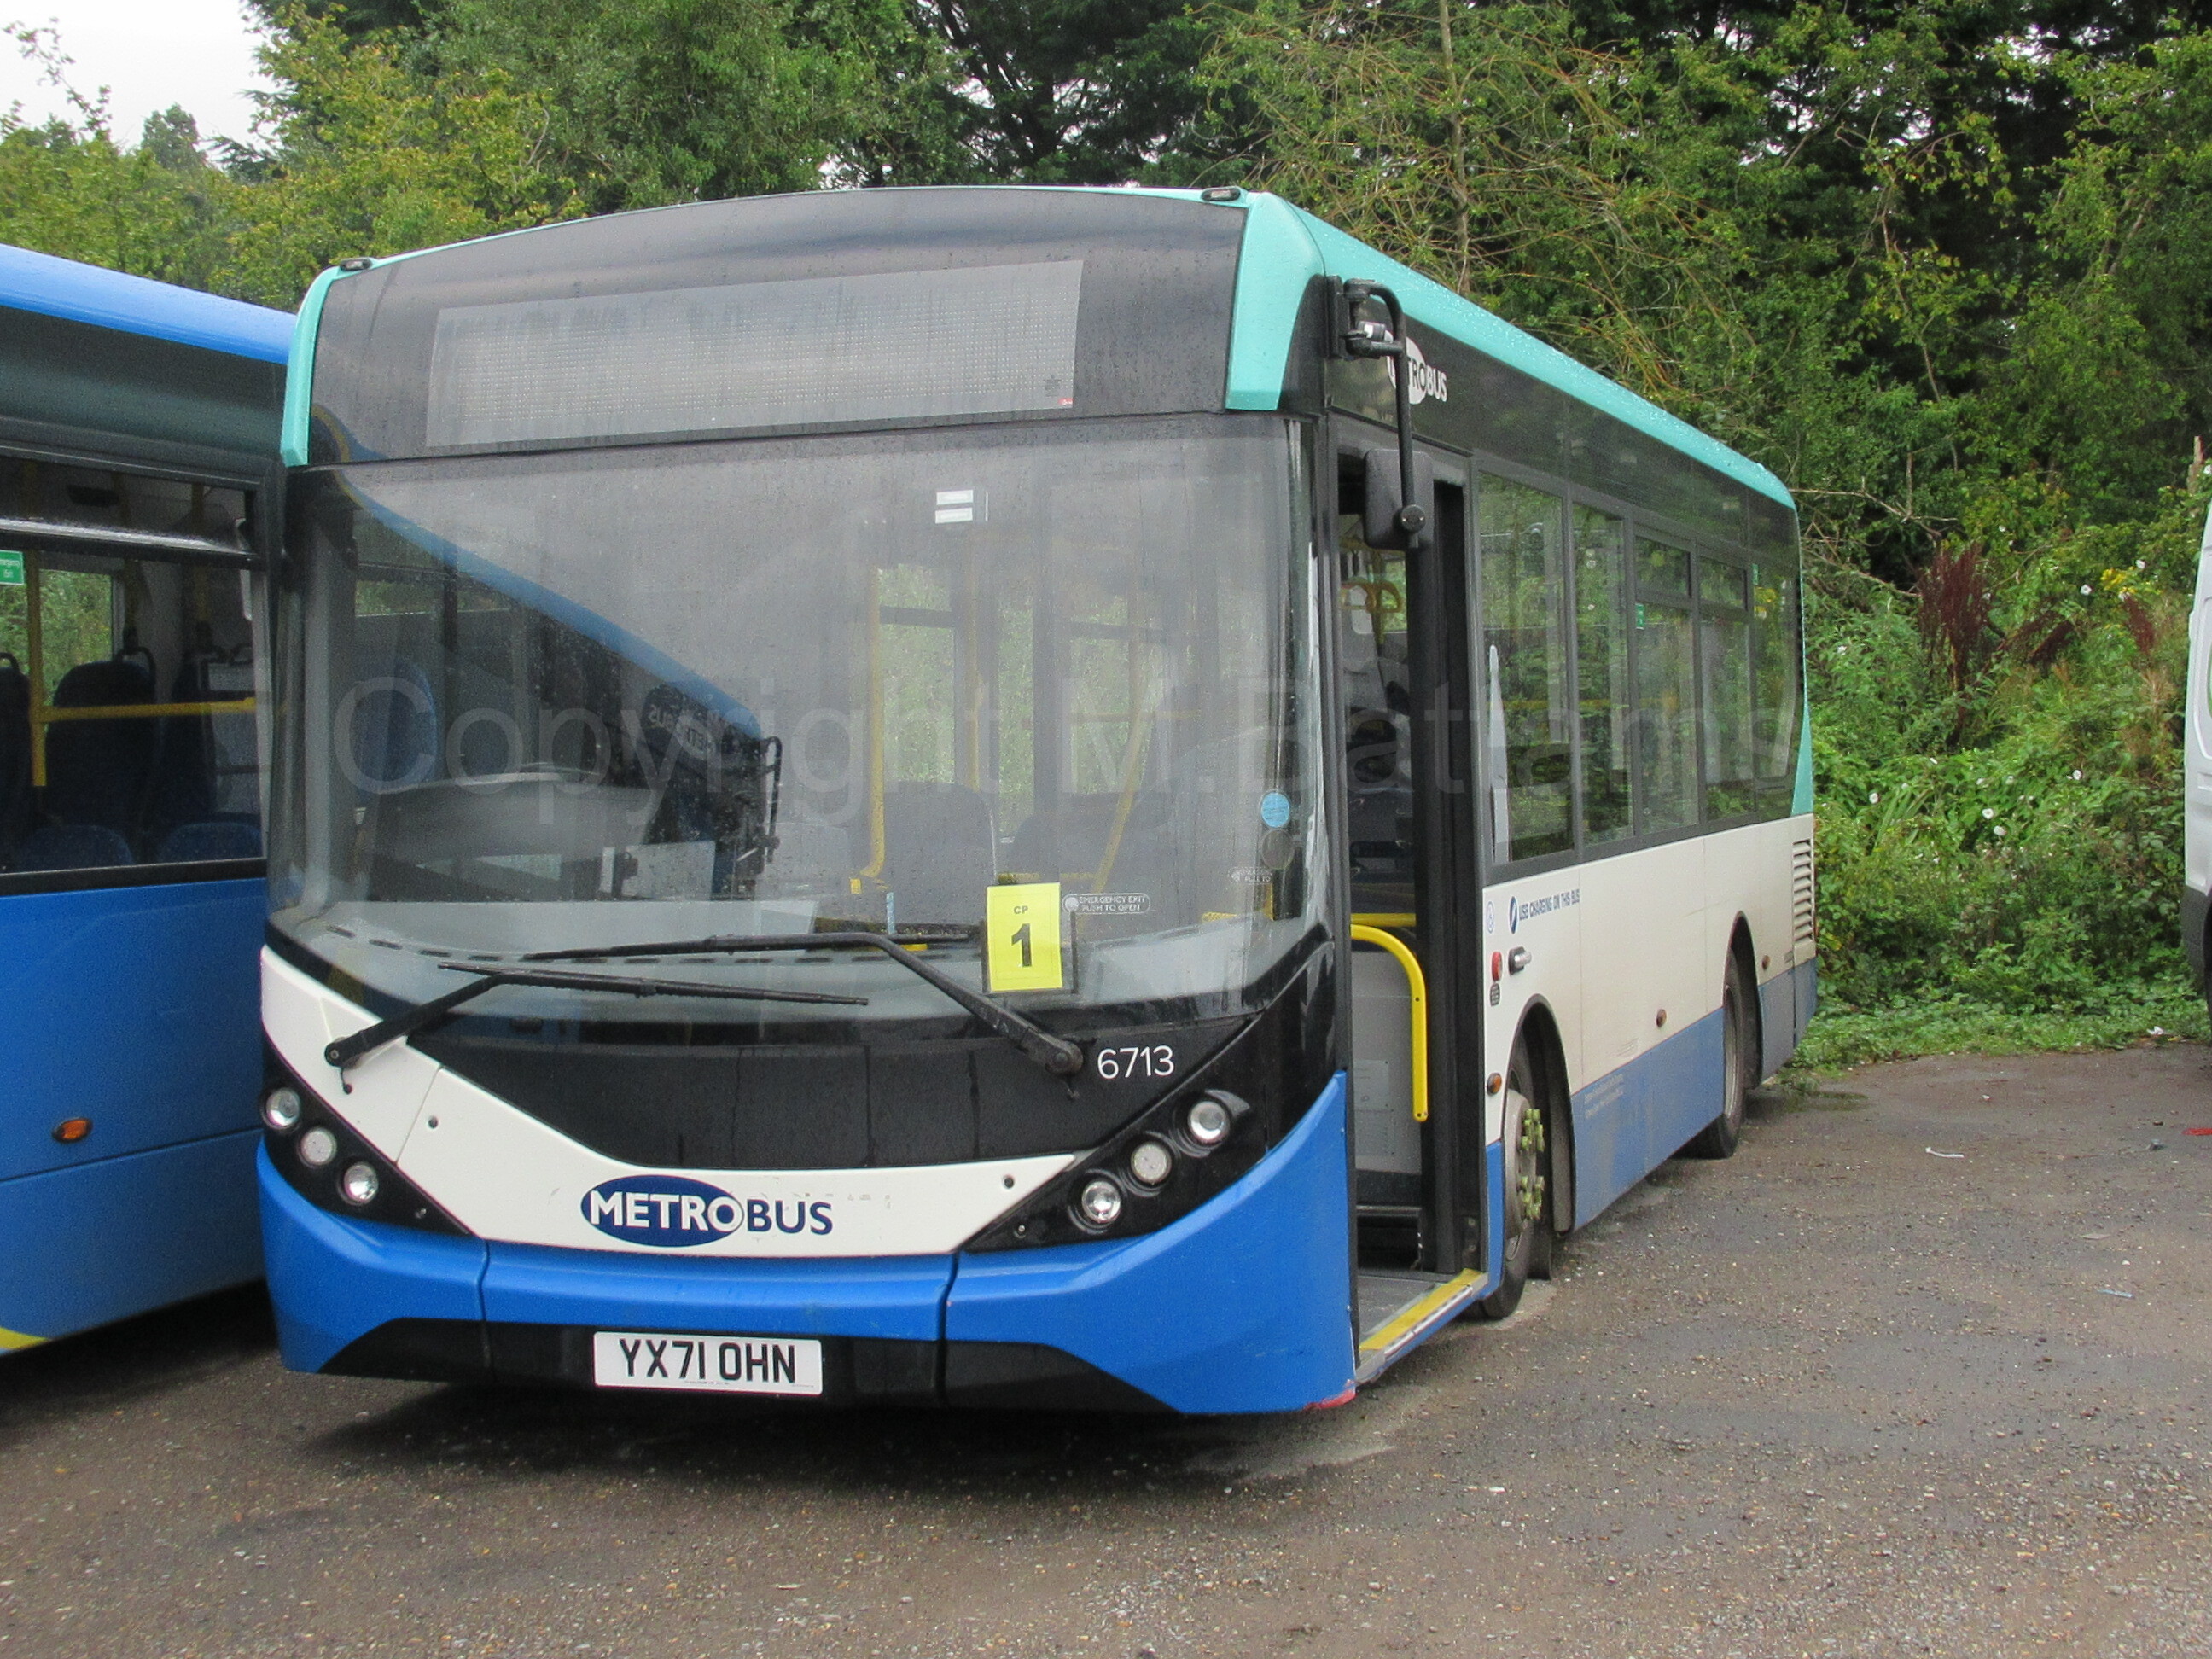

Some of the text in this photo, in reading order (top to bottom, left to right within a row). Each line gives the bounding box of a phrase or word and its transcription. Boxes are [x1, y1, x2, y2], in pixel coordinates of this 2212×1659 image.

[1013, 905, 1029, 915] CP
[1079, 895, 1126, 904] EMERGENCY
[1010, 923, 1033, 968] 1
[1097, 1045, 1174, 1080] 6713
[590, 1190, 833, 1236] METROBUS
[620, 1338, 795, 1383] YX71 OHN
